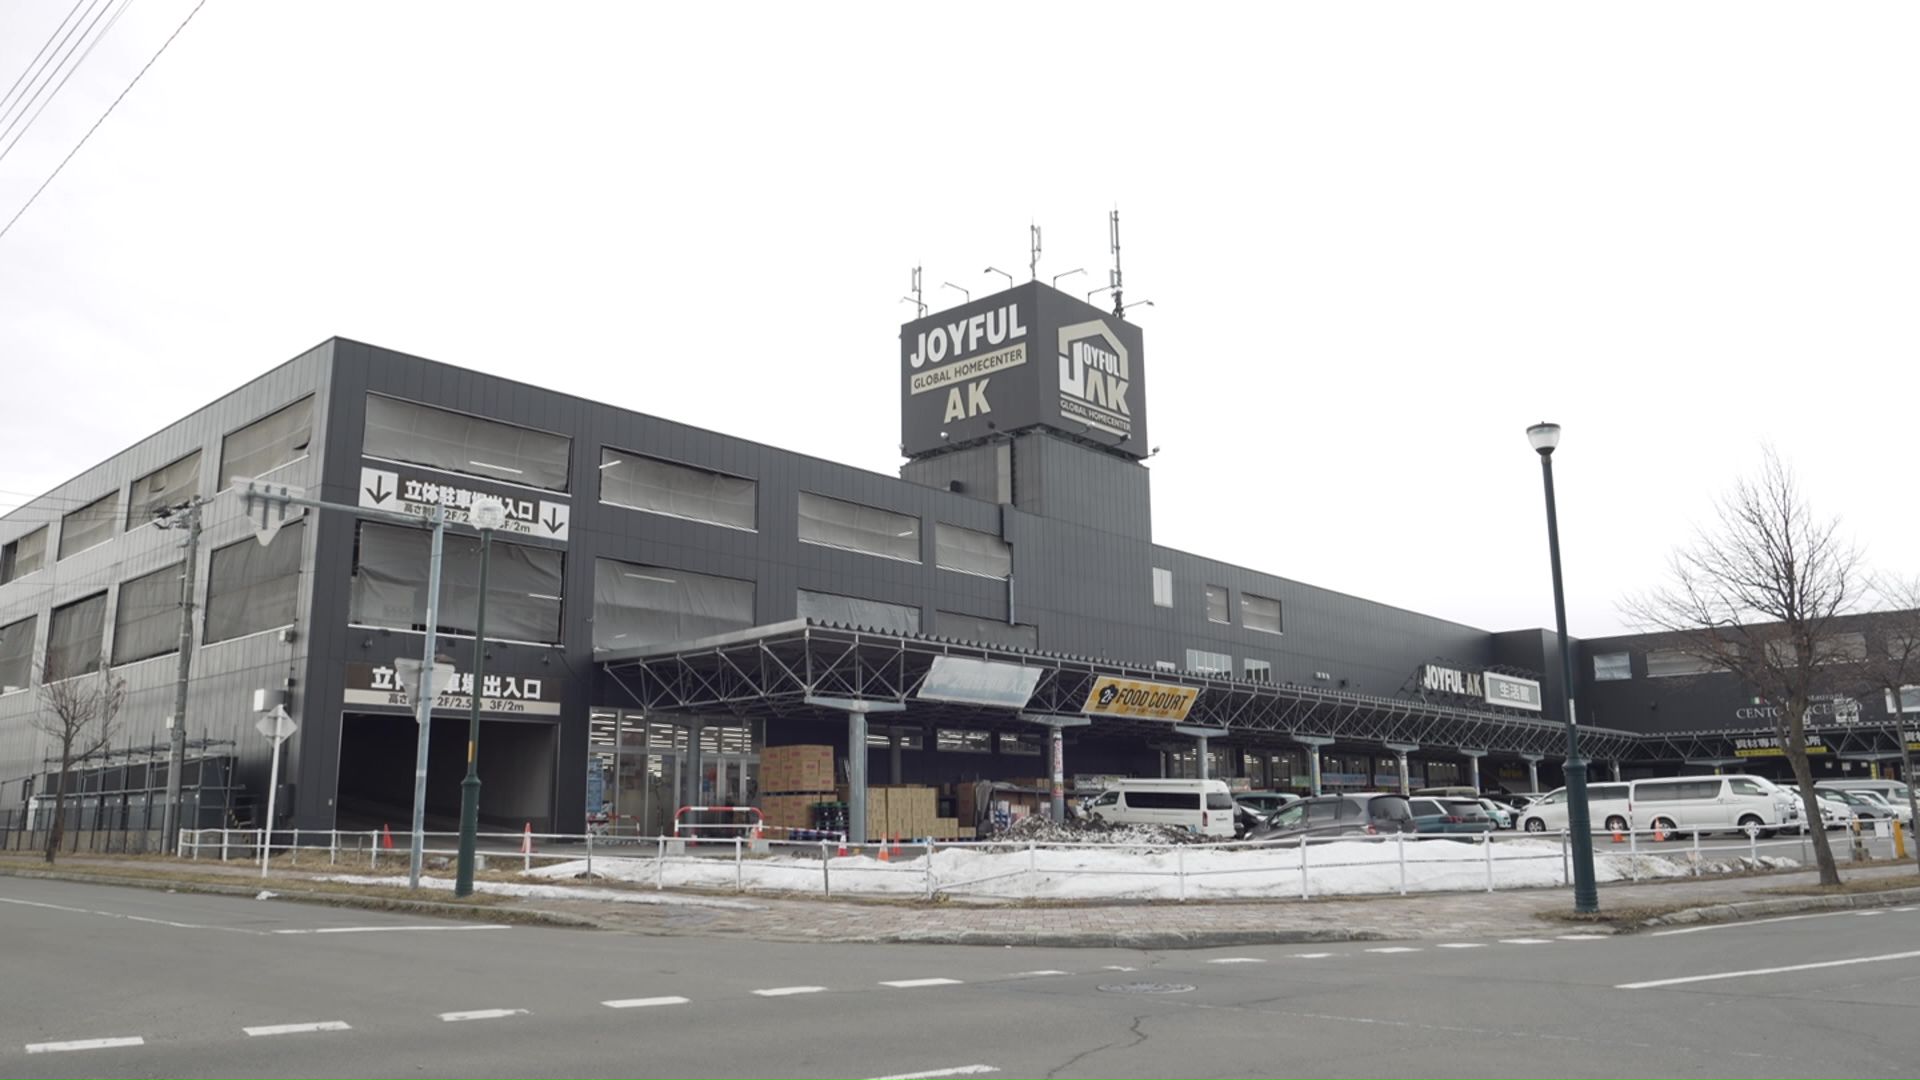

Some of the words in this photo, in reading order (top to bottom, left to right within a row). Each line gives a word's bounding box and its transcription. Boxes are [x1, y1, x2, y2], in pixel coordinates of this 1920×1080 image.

[910, 303, 1027, 368] JOYFUL
[913, 371, 951, 389] GLOBAL
[954, 348, 1023, 376] HOMECENTER
[944, 378, 991, 424] AK
[1060, 400, 1087, 417] GLOBAL
[1088, 409, 1131, 431] HOMECENTER
[404, 480, 534, 521] 立体駐車入口
[371, 666, 542, 699] 立車場出入口
[1424, 664, 1465, 694] JOYFUL
[1466, 673, 1483, 697] AK
[489, 700, 525, 711] 3F/2m
[1115, 687, 1150, 706] FOOD
[1148, 692, 1189, 711] COURT
